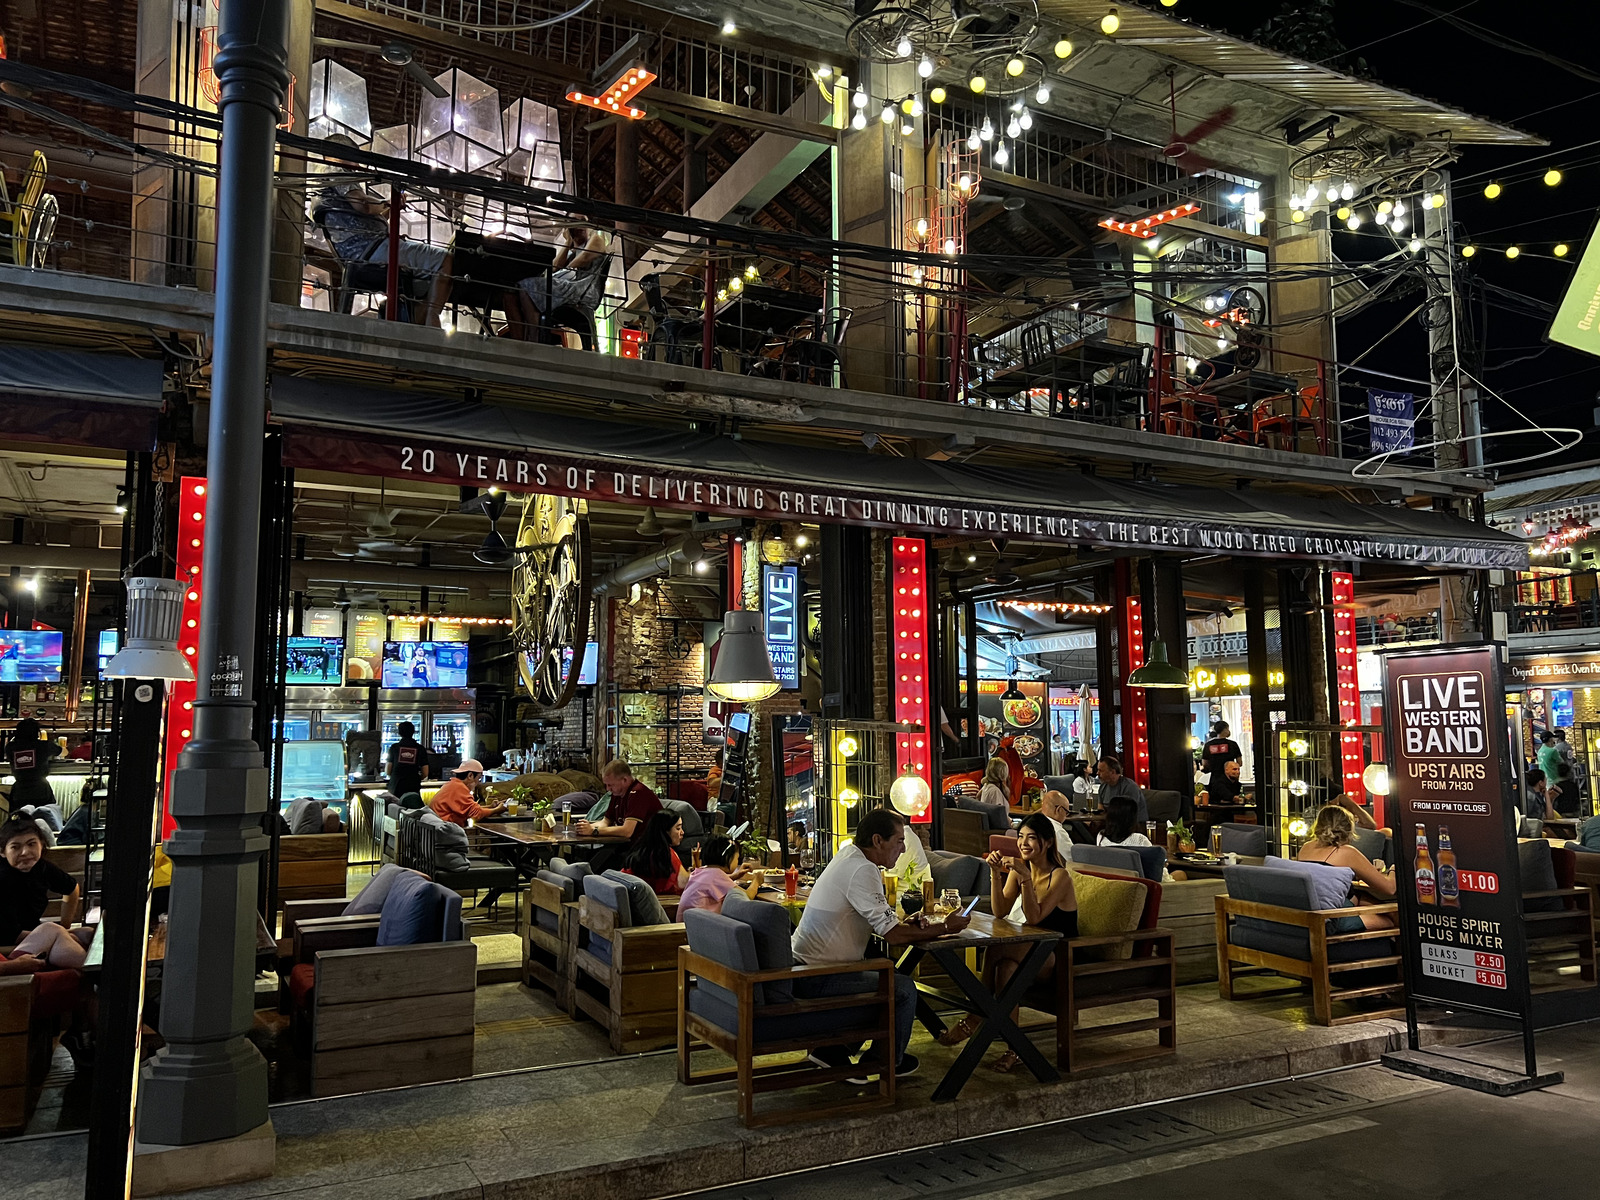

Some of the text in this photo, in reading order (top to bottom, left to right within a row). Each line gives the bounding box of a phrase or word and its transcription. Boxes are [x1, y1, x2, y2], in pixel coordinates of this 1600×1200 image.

[1374, 426, 1384, 436] 012
[1386, 429, 1398, 438] 493
[400, 446, 435, 472] 20
[456, 453, 548, 486] YEARS
[566, 467, 596, 491] OF
[614, 472, 764, 510] DELIVERING
[780, 491, 848, 518] GREAT
[862, 500, 948, 527] DINNING
[962, 509, 1080, 538] EXPERIENCE
[1108, 522, 1139, 542] THE
[1150, 526, 1190, 546] BEST
[1200, 530, 1243, 550] WOOD
[1252, 534, 1296, 553] FIRED
[1305, 536, 1382, 558] CROCODILE
[1389, 544, 1427, 560] PIZZA
[769, 576, 793, 640] LIVE
[767, 644, 795, 653] WESTERN
[1553, 664, 1572, 675] Brick
[1572, 664, 1590, 674] Oven
[1402, 676, 1480, 710] LIVE
[1405, 710, 1482, 727] WESTERN
[1406, 726, 1484, 754] BAND
[1408, 763, 1486, 780] UPSTAIRS
[1422, 780, 1474, 791] FROM 7H30
[1413, 802, 1487, 812] FROM 10 PM TO CLOSE
[1462, 872, 1496, 891] $1.00
[1418, 912, 1501, 934] HOUSE SPIRIT
[1418, 926, 1504, 950] PLUS MIXER
[1428, 947, 1502, 968] GLASS $2.50
[1430, 964, 1503, 986] BUCKET $5.00
